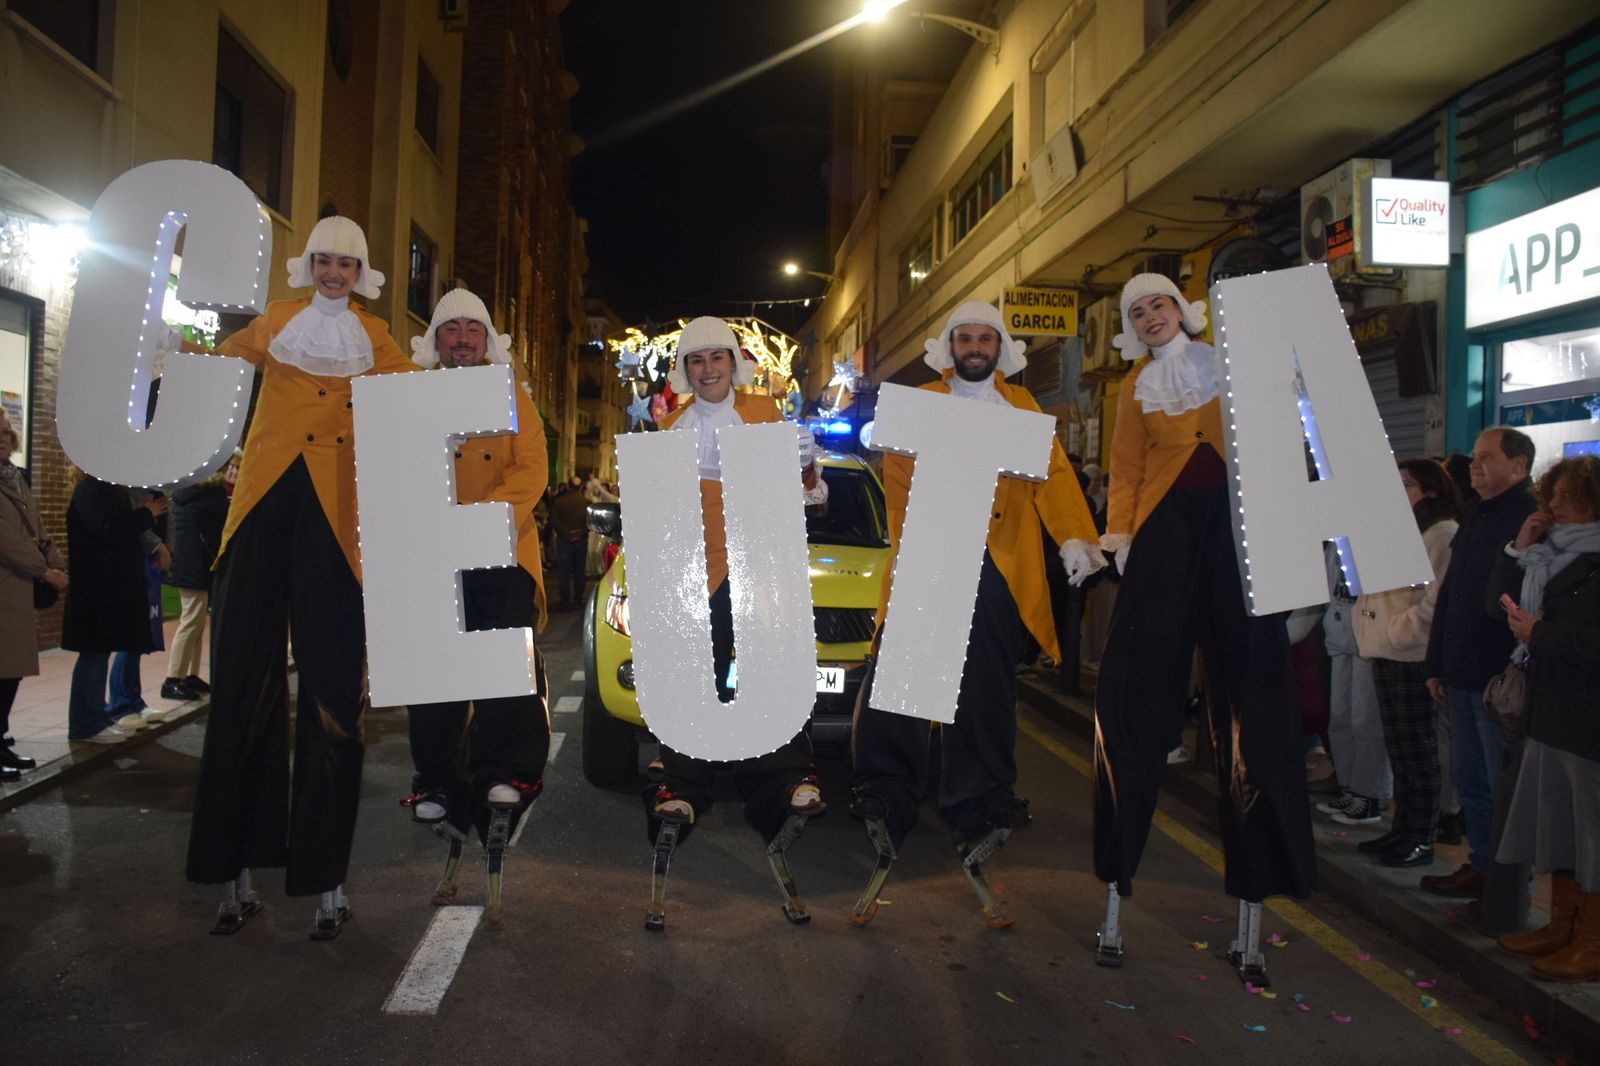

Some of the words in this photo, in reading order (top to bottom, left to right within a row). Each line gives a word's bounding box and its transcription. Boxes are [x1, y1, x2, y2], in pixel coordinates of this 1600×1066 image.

[1400, 198, 1446, 216] Quality
[1401, 213, 1426, 227] Like
[1004, 291, 1075, 308] ALIMENTACION
[1011, 313, 1066, 330] GARCIA
